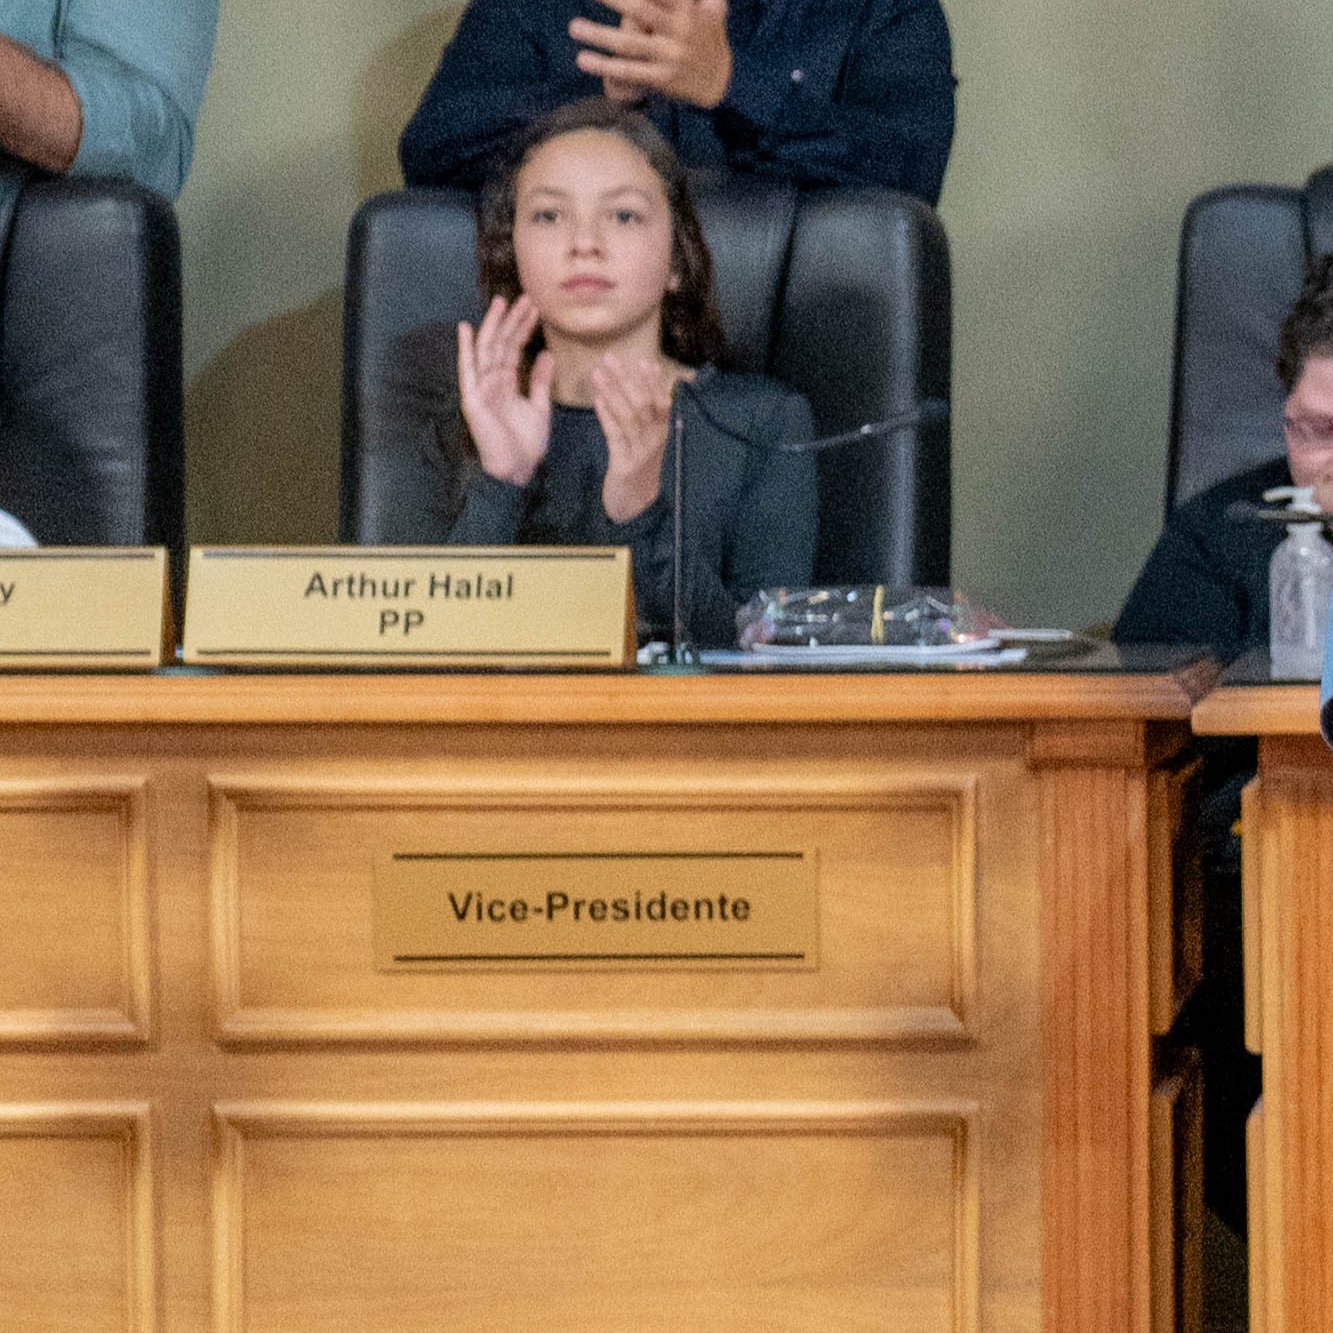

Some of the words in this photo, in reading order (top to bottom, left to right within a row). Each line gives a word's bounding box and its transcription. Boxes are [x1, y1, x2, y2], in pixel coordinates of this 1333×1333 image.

[304, 572, 415, 599] Arthur
[428, 572, 514, 599] Halal
[379, 609, 425, 635] PP
[447, 890, 751, 923] Vice-Presidente
